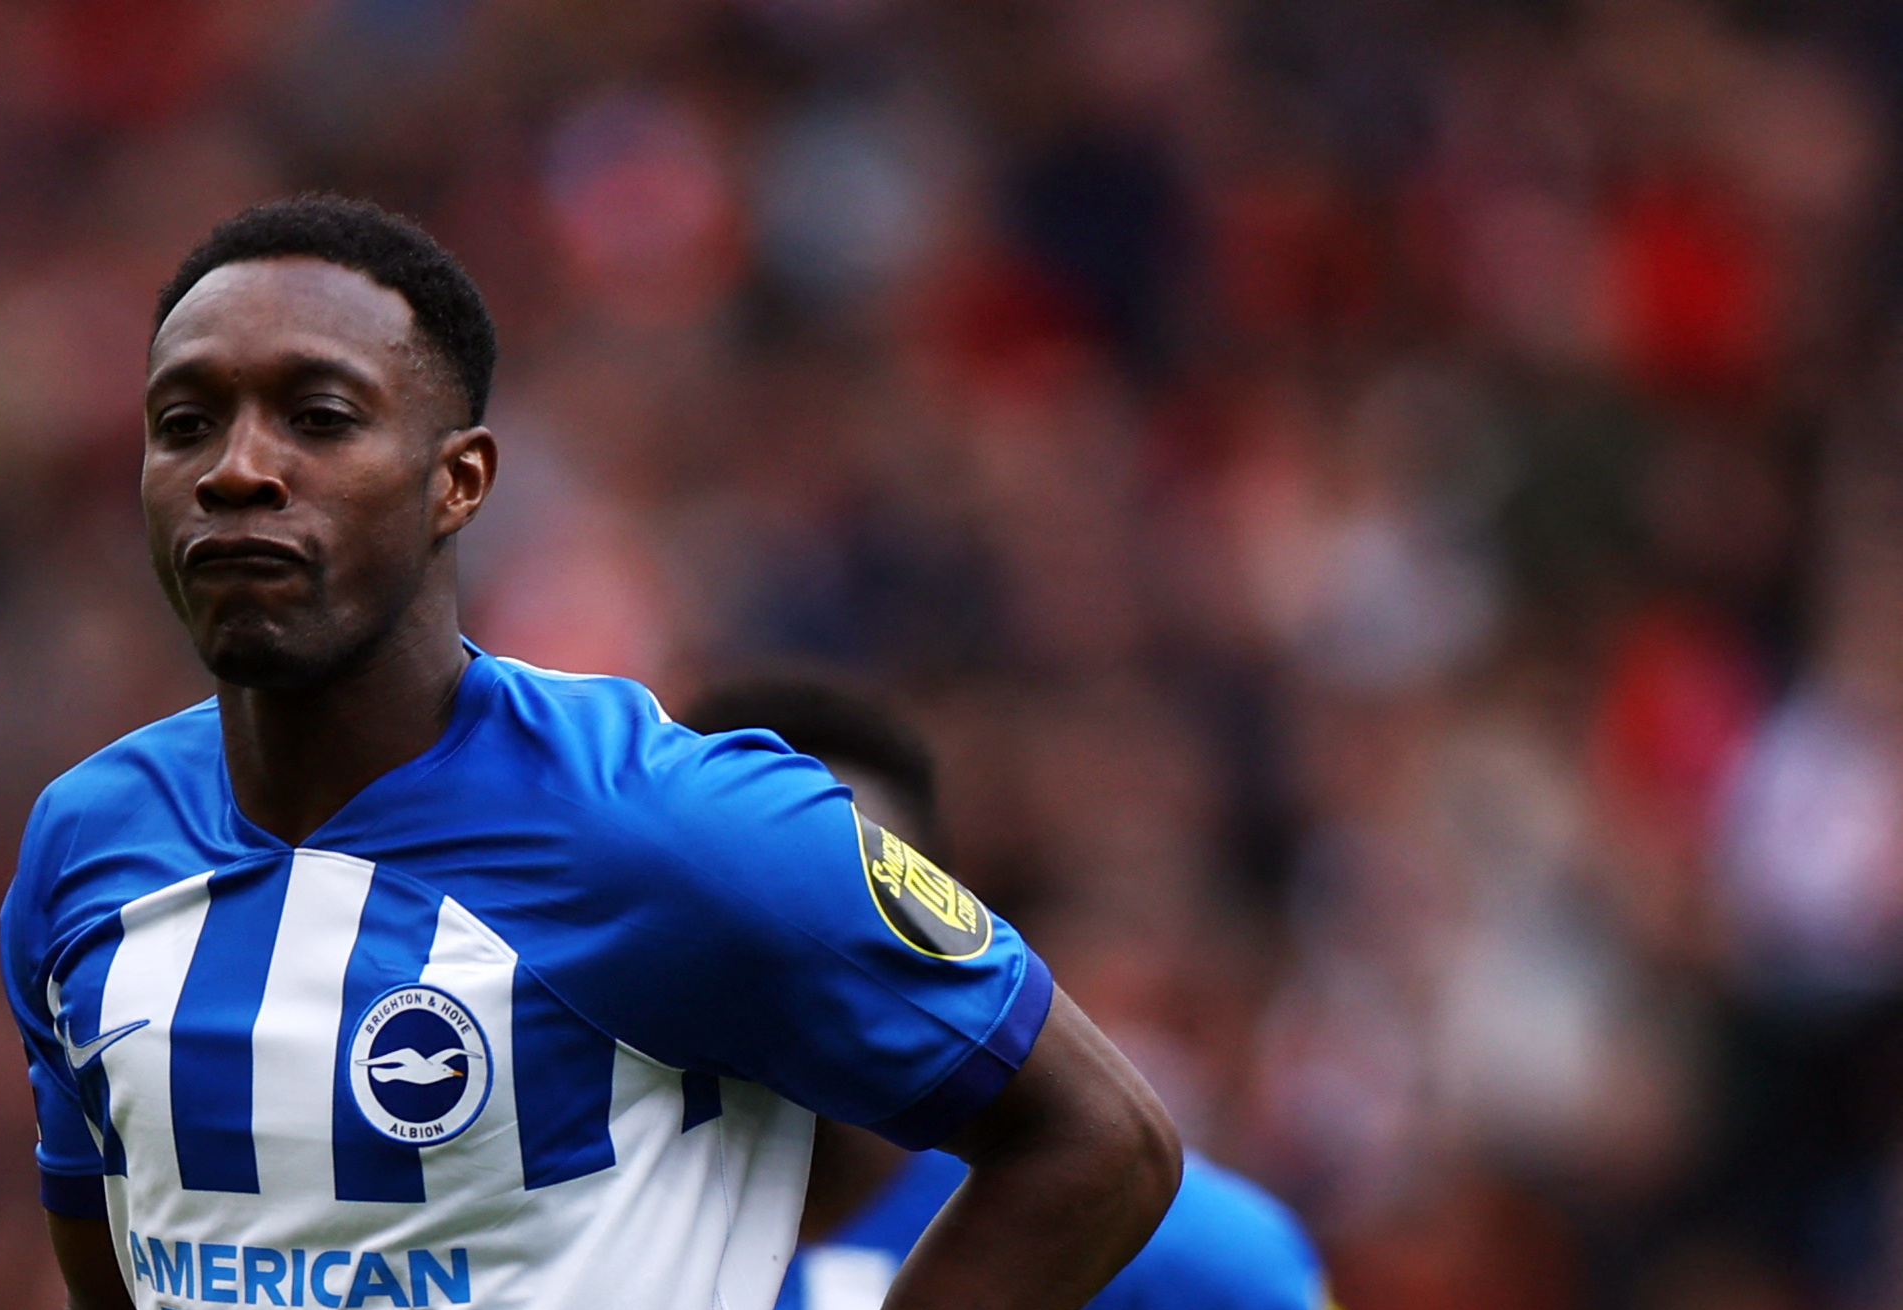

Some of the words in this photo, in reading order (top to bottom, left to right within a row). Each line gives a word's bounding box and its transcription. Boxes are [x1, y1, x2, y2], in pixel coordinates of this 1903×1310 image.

[364, 992, 422, 1035] BRIGHTON
[427, 995, 437, 1008] &
[440, 1003, 472, 1035] HOVE
[389, 1122, 445, 1139] ALBION
[129, 1229, 472, 1309] AMERICAN
